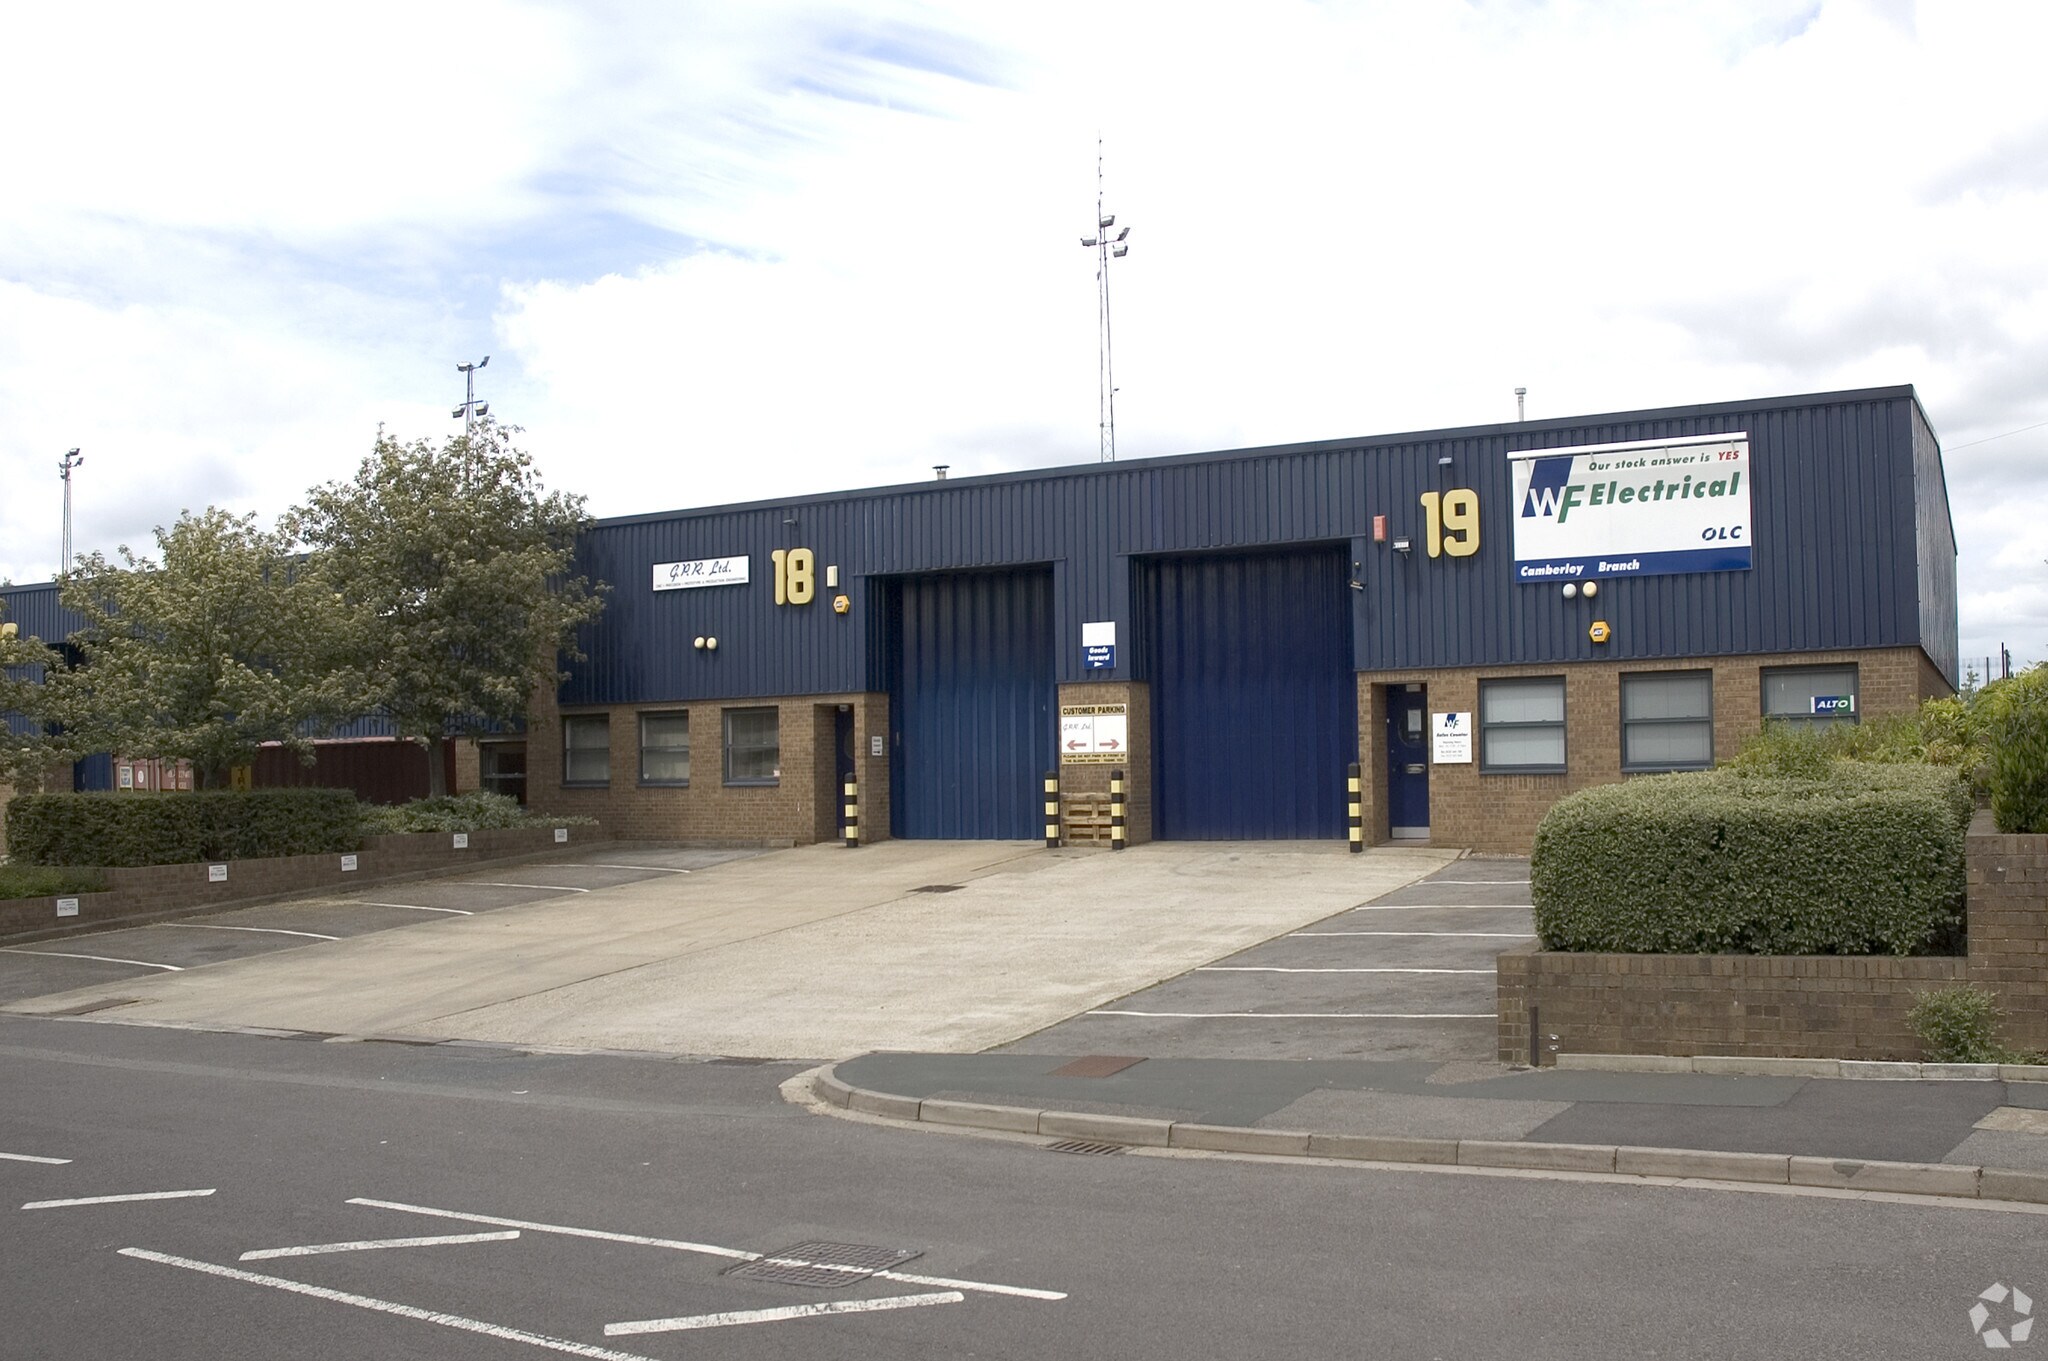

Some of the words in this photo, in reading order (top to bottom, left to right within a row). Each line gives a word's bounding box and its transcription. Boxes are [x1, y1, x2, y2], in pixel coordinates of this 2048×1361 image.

[1589, 461, 1611, 472] Our
[1615, 457, 1646, 470] stock
[1651, 454, 1695, 466] answer
[1700, 452, 1710, 463] is
[1718, 450, 1740, 461] YES
[1522, 485, 1585, 523] WF
[1589, 471, 1740, 506] Electrical
[1420, 488, 1480, 558] 19
[1702, 525, 1742, 541] OLC
[709, 560, 732, 576] Ltd.
[771, 547, 815, 606] 18
[1520, 562, 1584, 577] Camberley
[1598, 558, 1640, 573] Branch
[1063, 707, 1095, 715] CUSTOMER
[1098, 705, 1125, 714] PARKING
[1817, 700, 1848, 709] ALTO
